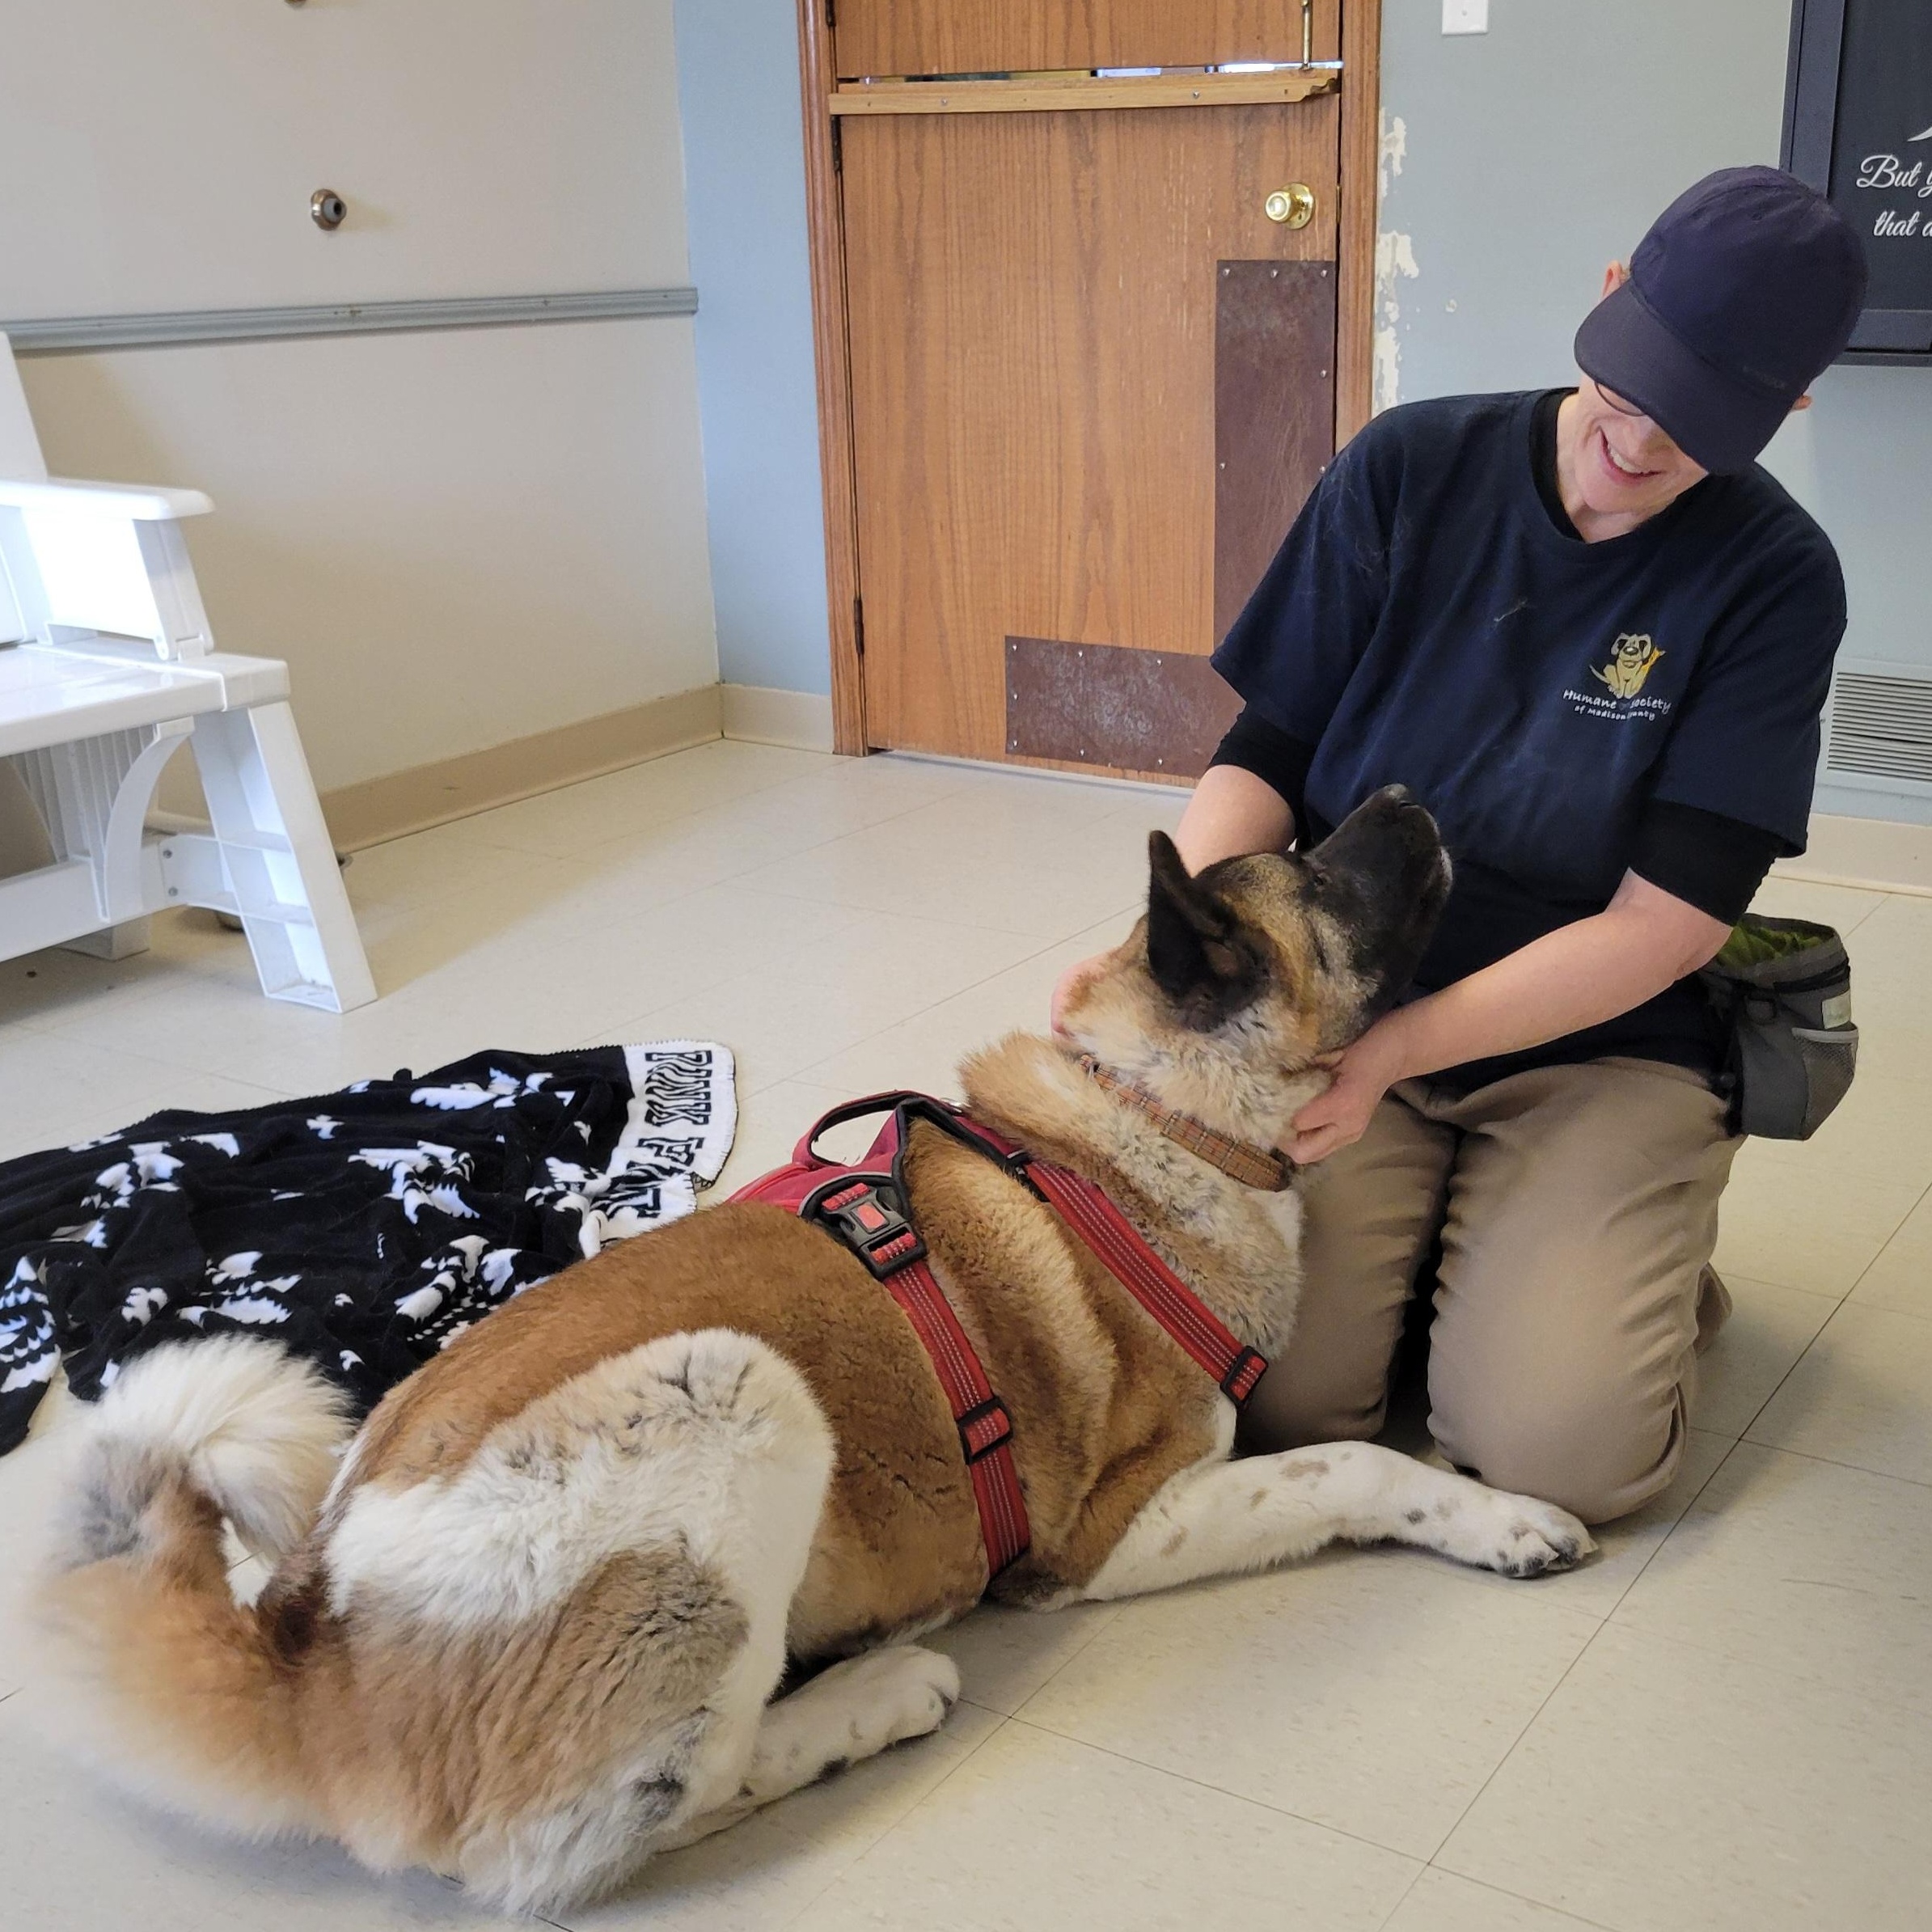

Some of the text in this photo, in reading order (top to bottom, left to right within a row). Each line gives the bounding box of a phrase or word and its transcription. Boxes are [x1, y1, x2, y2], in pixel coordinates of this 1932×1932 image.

[1856, 154, 1922, 188] But
[1873, 210, 1921, 237] that
[1563, 689, 1617, 709] Humane
[1575, 705, 1586, 715] of
[1587, 708, 1626, 721] Madison
[644, 1050, 712, 1126] PINK
